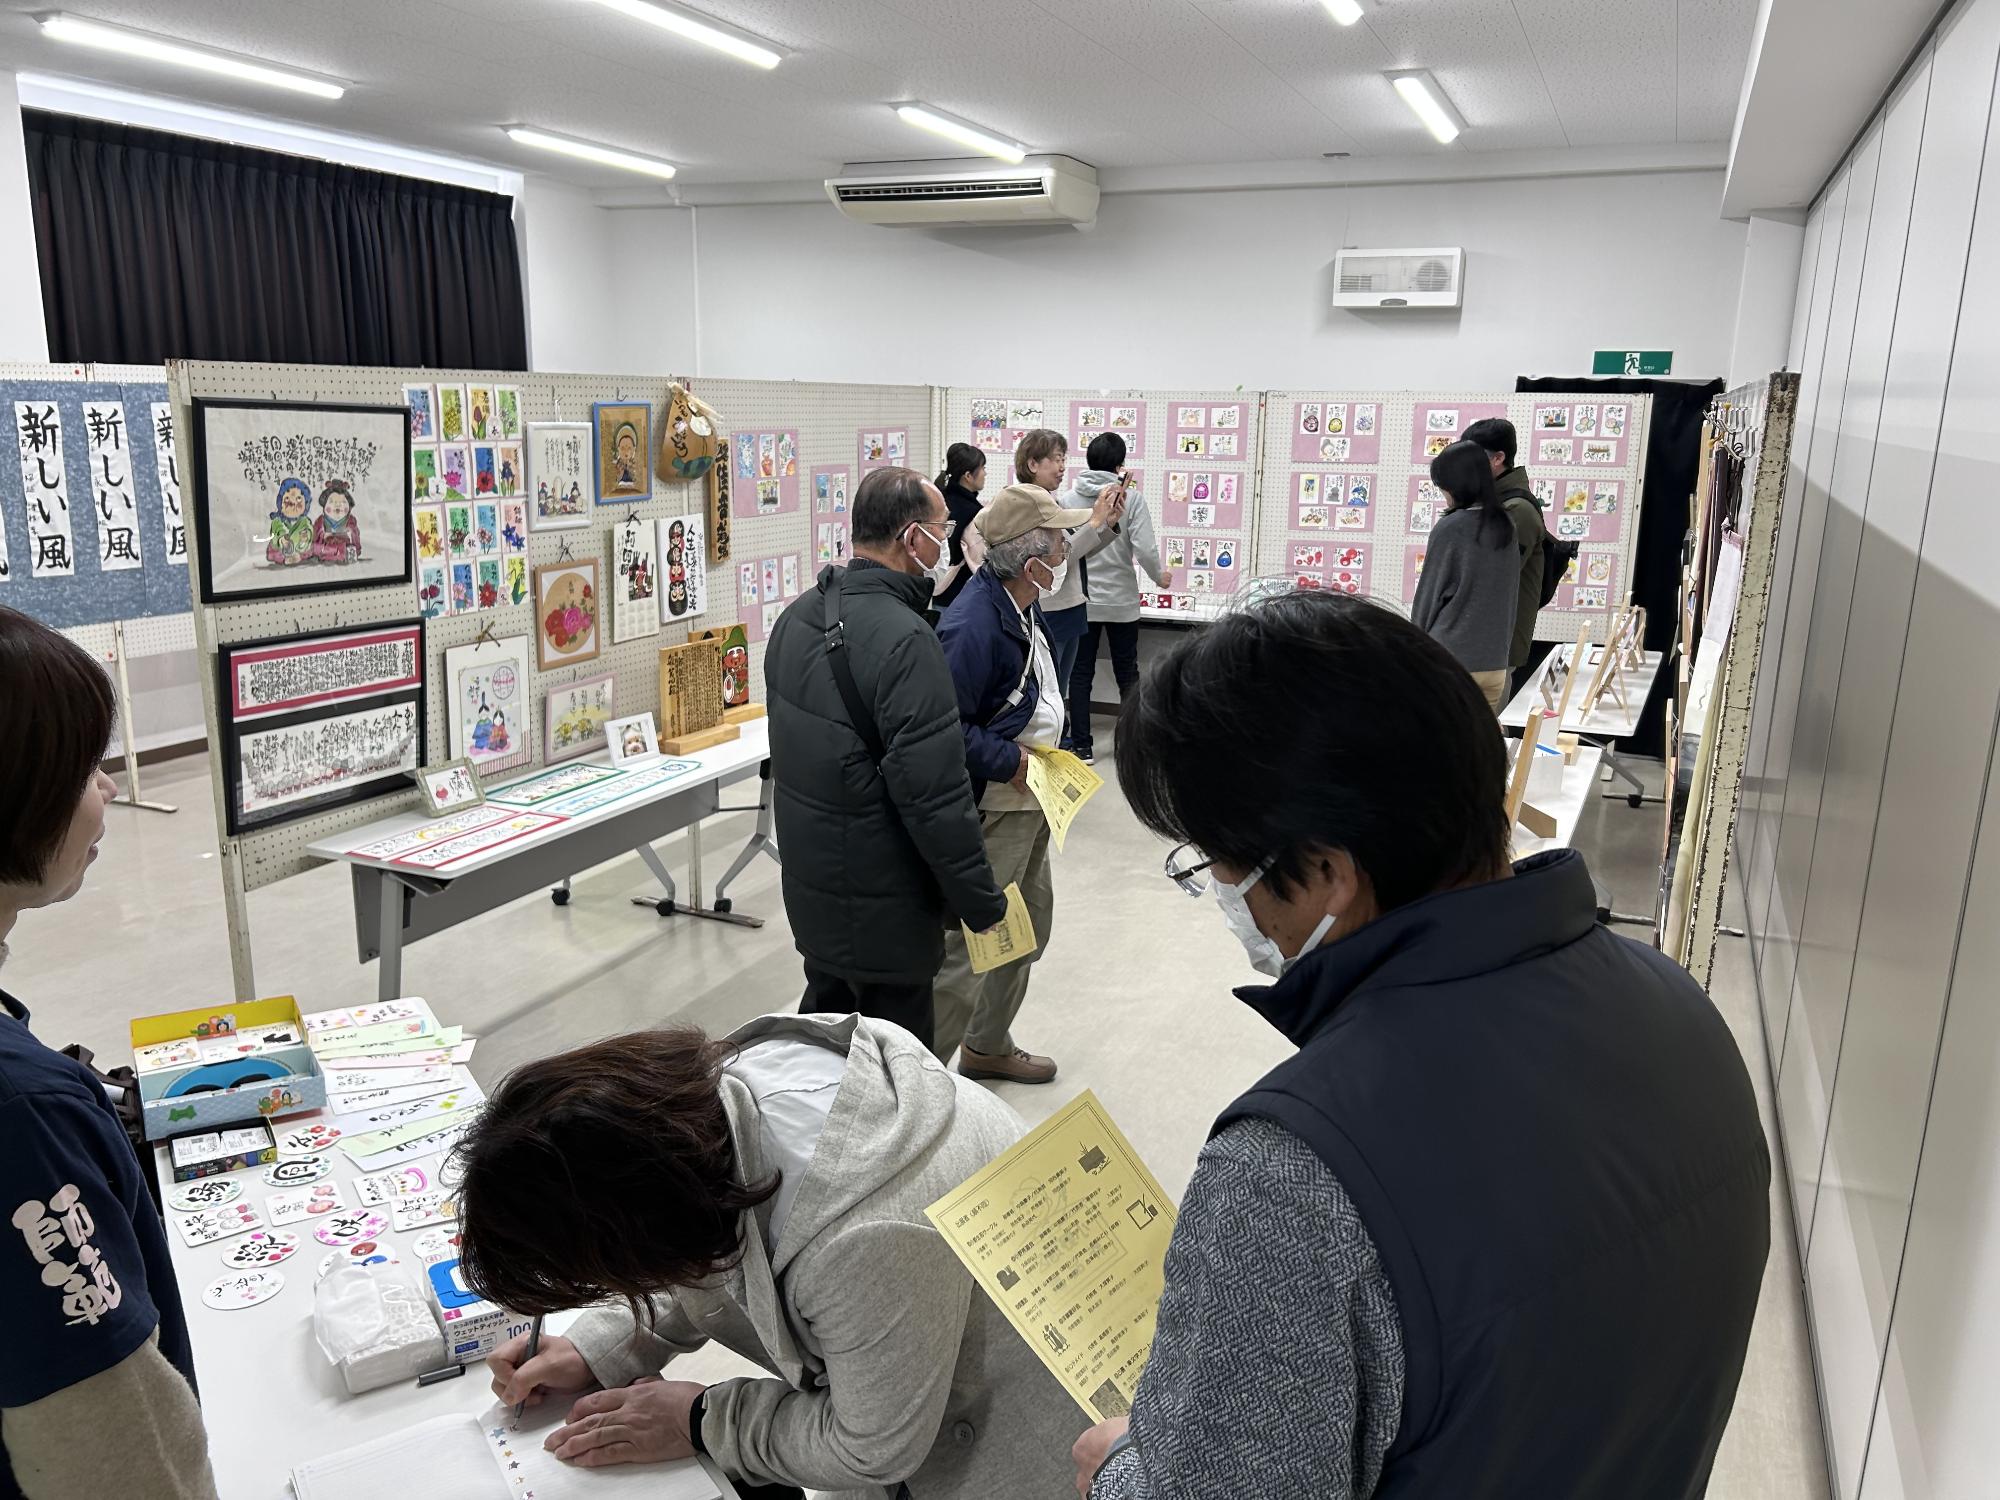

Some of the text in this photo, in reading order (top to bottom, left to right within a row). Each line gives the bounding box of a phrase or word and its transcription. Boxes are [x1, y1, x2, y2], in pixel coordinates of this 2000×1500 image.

[20, 405, 71, 569] 新しい風
[88, 407, 139, 561] 新しい風
[455, 1318, 511, 1337] ウェットティッシュ
